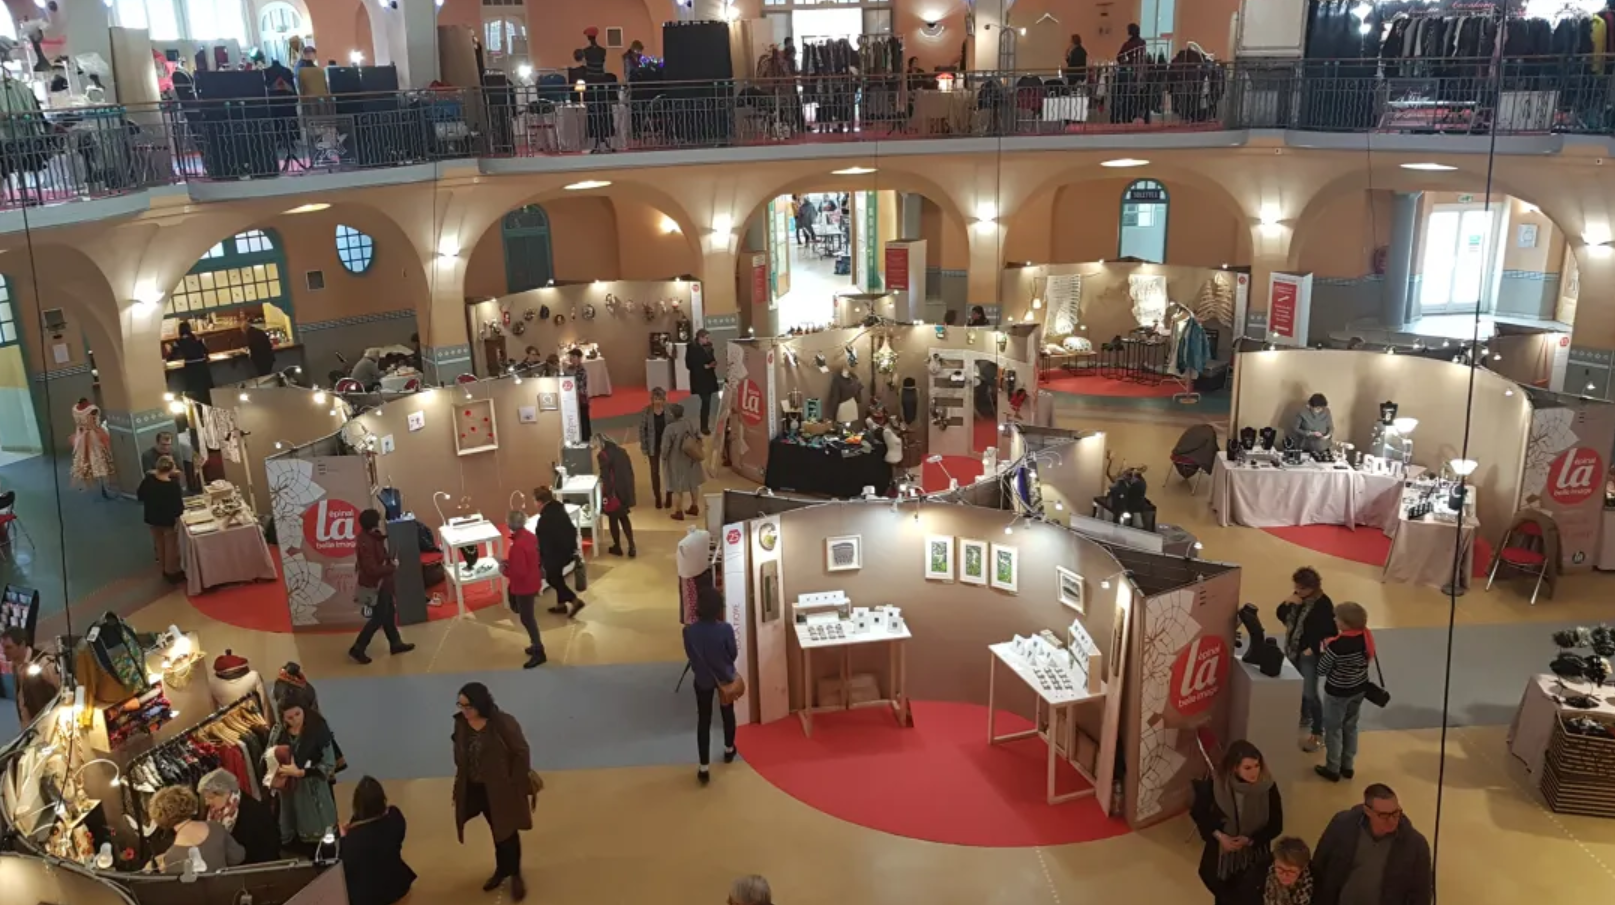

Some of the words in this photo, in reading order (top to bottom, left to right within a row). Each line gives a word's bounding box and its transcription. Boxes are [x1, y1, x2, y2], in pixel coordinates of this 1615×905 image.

[742, 379, 759, 413] la
[1556, 448, 1594, 488] la
[316, 499, 356, 541] la
[328, 509, 354, 518] épinal
[316, 540, 335, 550] belle
[728, 532, 739, 542] 25
[1181, 638, 1219, 696] la
